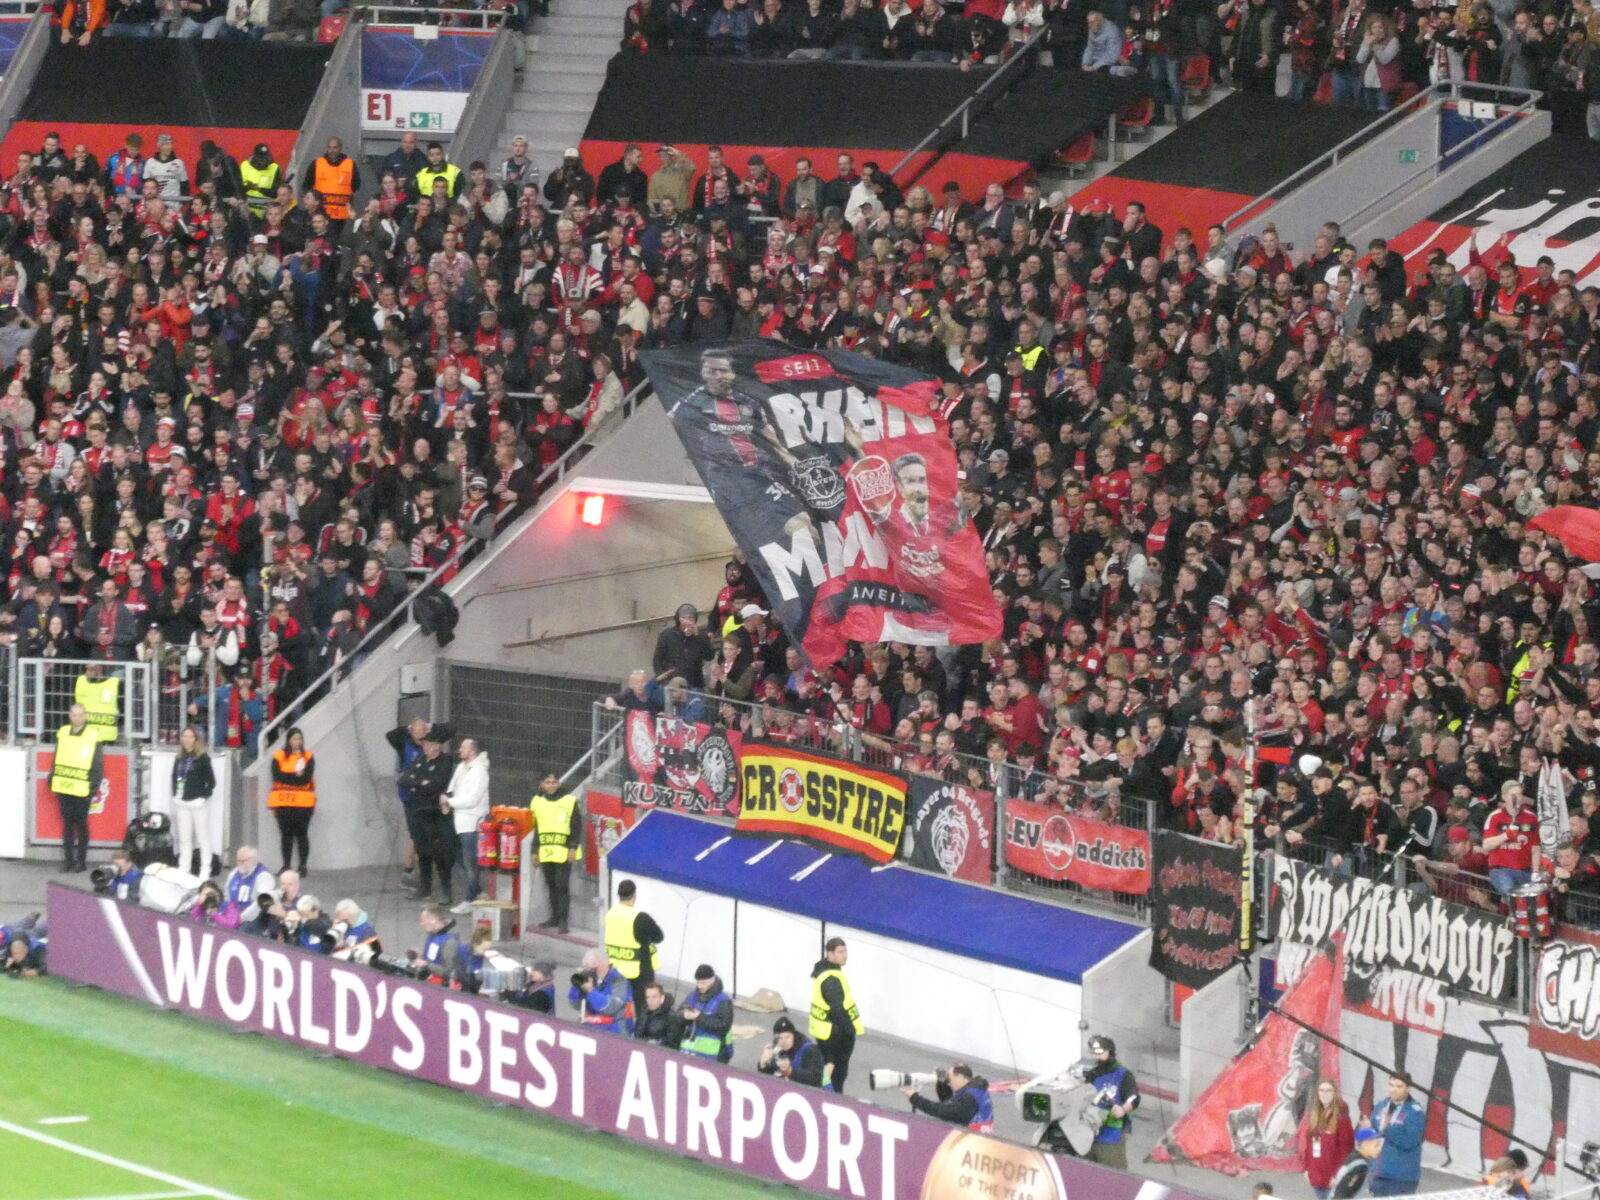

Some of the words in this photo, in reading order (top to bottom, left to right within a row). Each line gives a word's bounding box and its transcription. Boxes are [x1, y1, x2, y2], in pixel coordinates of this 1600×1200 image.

[367, 93, 392, 121] E1
[1076, 838, 1147, 870] addicts
[157, 920, 426, 1071] WORLD'S
[443, 999, 598, 1117] BEST
[615, 1049, 909, 1200] AIRPORT
[961, 1151, 1039, 1186] AIRPORT
[958, 1175, 973, 1188] OF
[978, 1180, 999, 1197] THE
